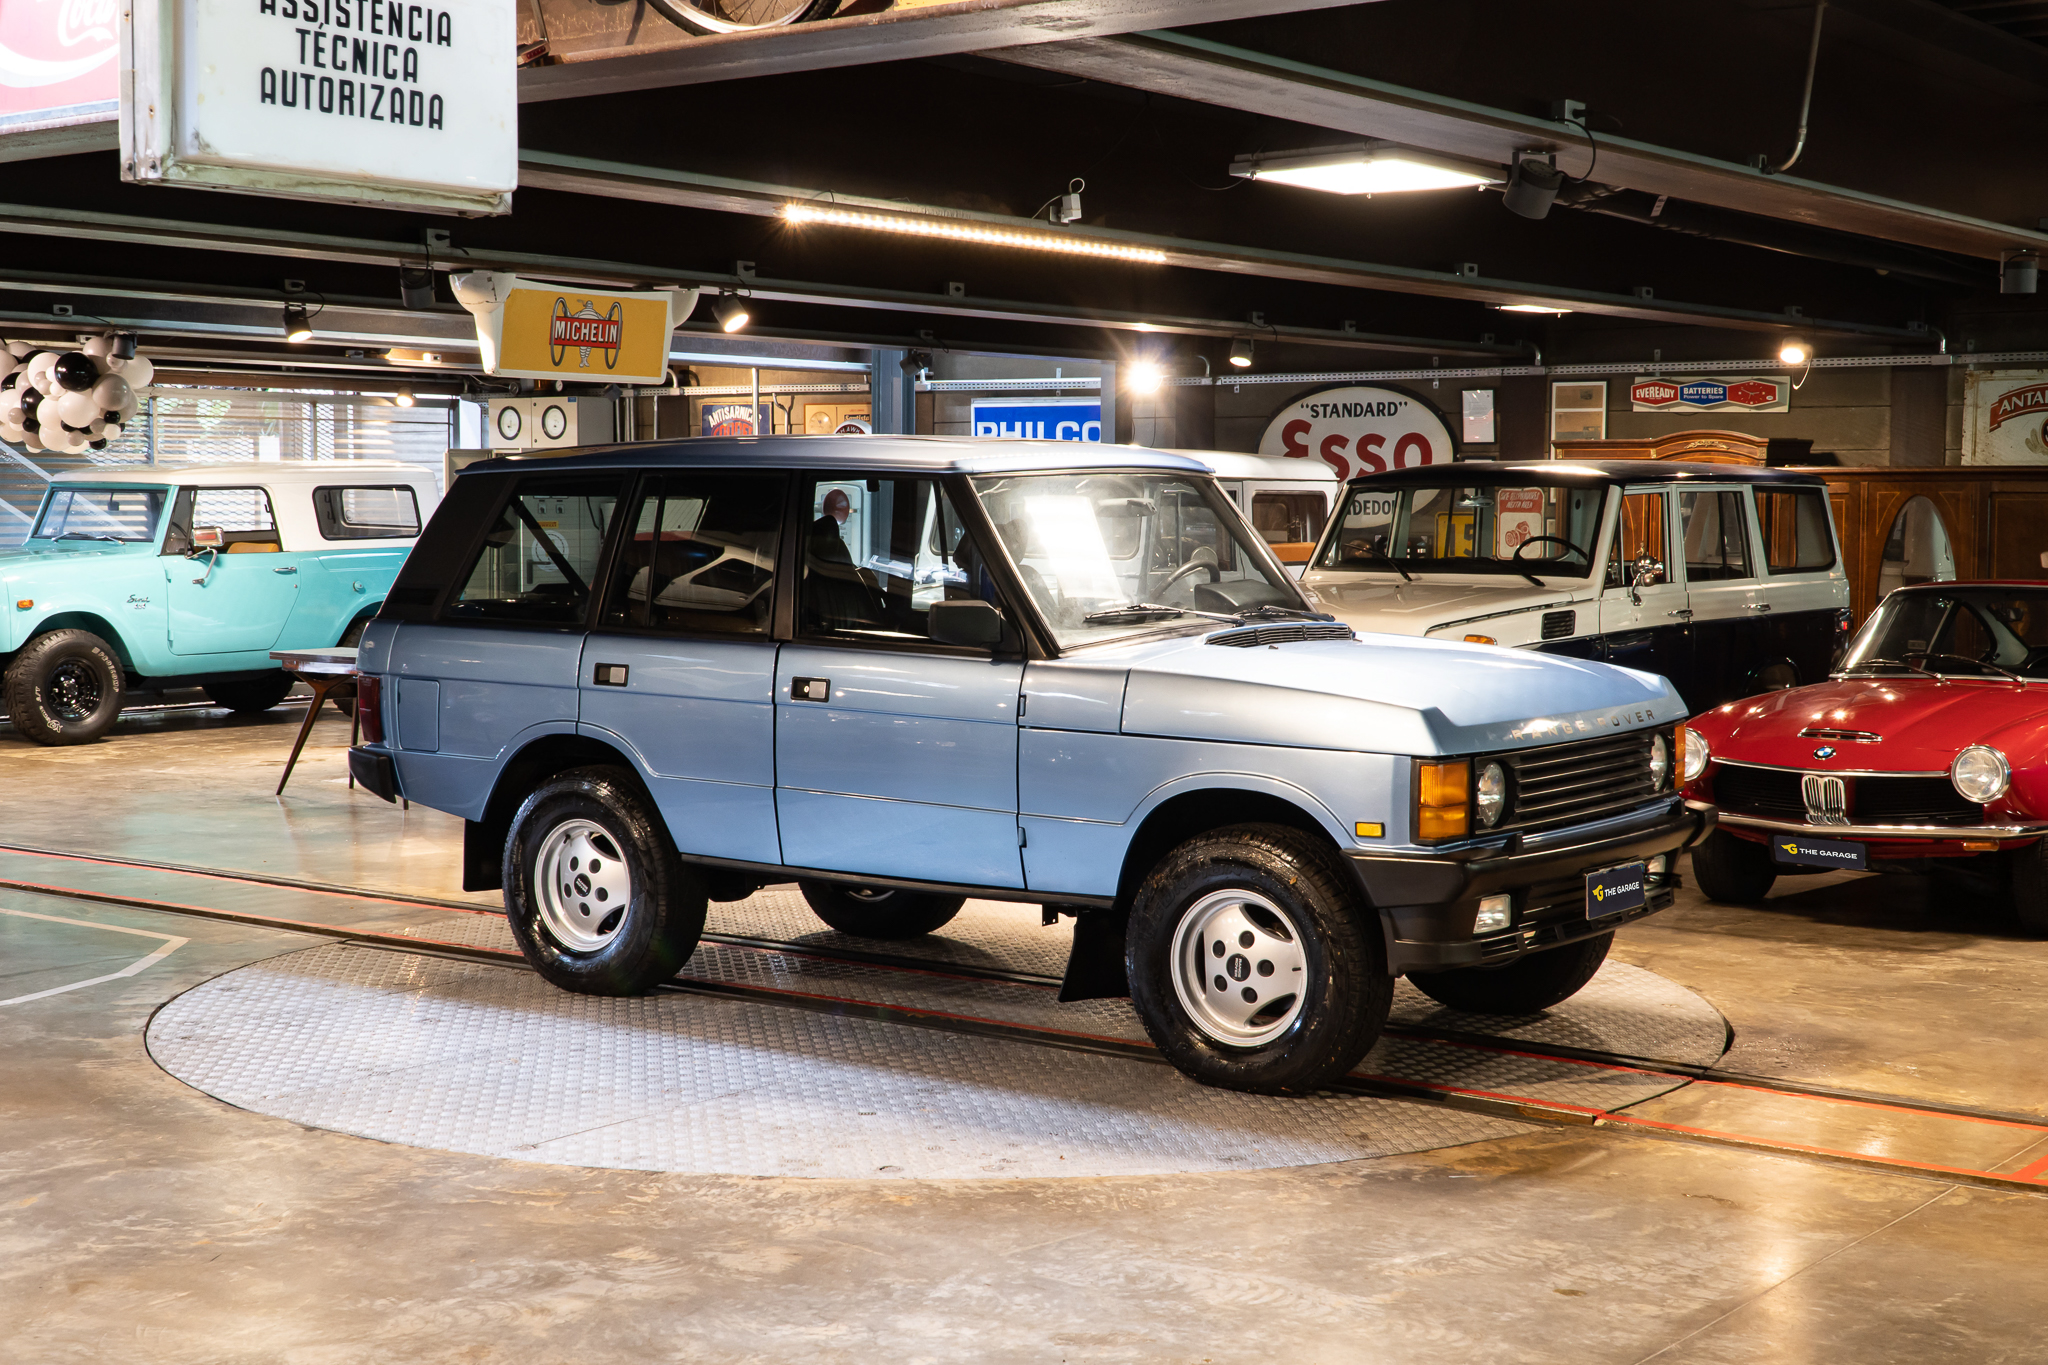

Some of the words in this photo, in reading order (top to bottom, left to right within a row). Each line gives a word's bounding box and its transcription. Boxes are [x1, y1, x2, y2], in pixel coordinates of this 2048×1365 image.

[295, 22, 418, 83] TÉCNICA
[260, 67, 443, 130] AUTORIZADA
[554, 320, 618, 343] MICHELIN
[1636, 386, 1675, 398] EVEREADY
[1683, 387, 1724, 395] BATTERIES
[1999, 389, 2048, 414] ANTA
[1511, 719, 1588, 741] RANGE
[1596, 709, 1656, 727] ROVER
[1799, 848, 1818, 856] THE
[1819, 850, 1858, 860] GARAGE
[1604, 887, 1617, 897] THE
[1617, 881, 1640, 894] GARAGE
